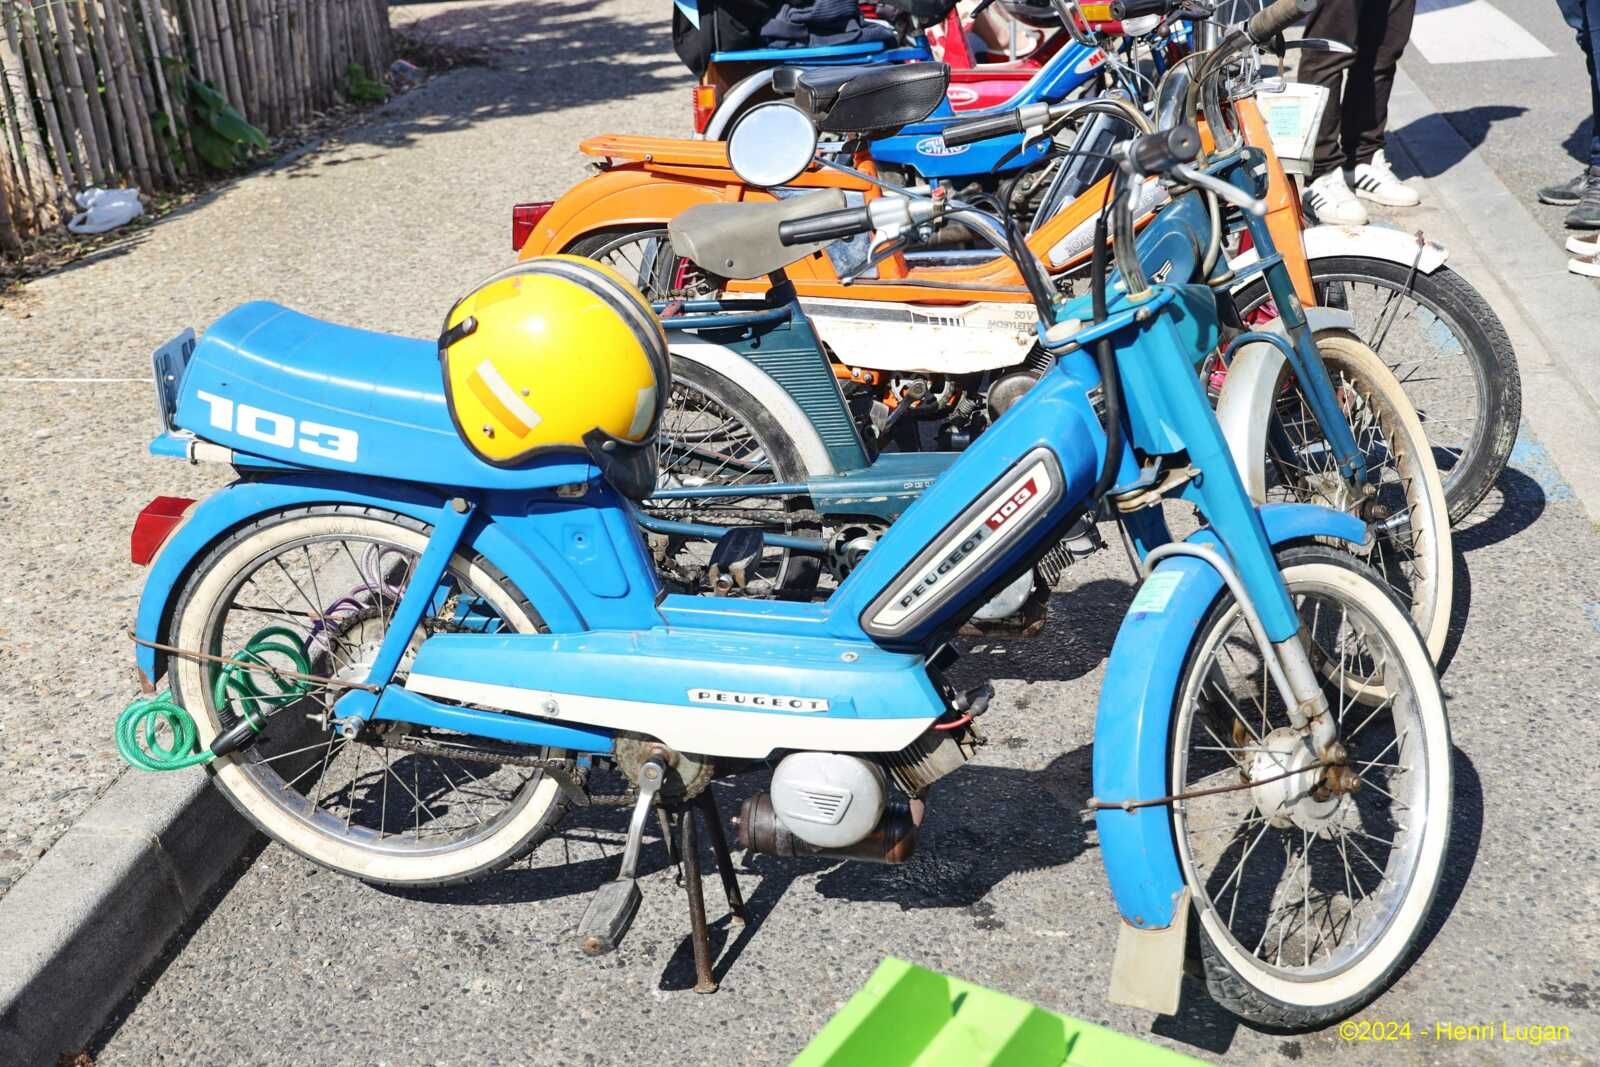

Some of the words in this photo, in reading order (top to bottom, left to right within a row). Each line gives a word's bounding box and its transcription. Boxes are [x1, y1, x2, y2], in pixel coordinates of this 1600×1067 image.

[197, 389, 359, 463] 103
[900, 530, 983, 608] PEUGEOT
[991, 487, 1032, 524] 103
[698, 691, 819, 710] PEUGEOT
